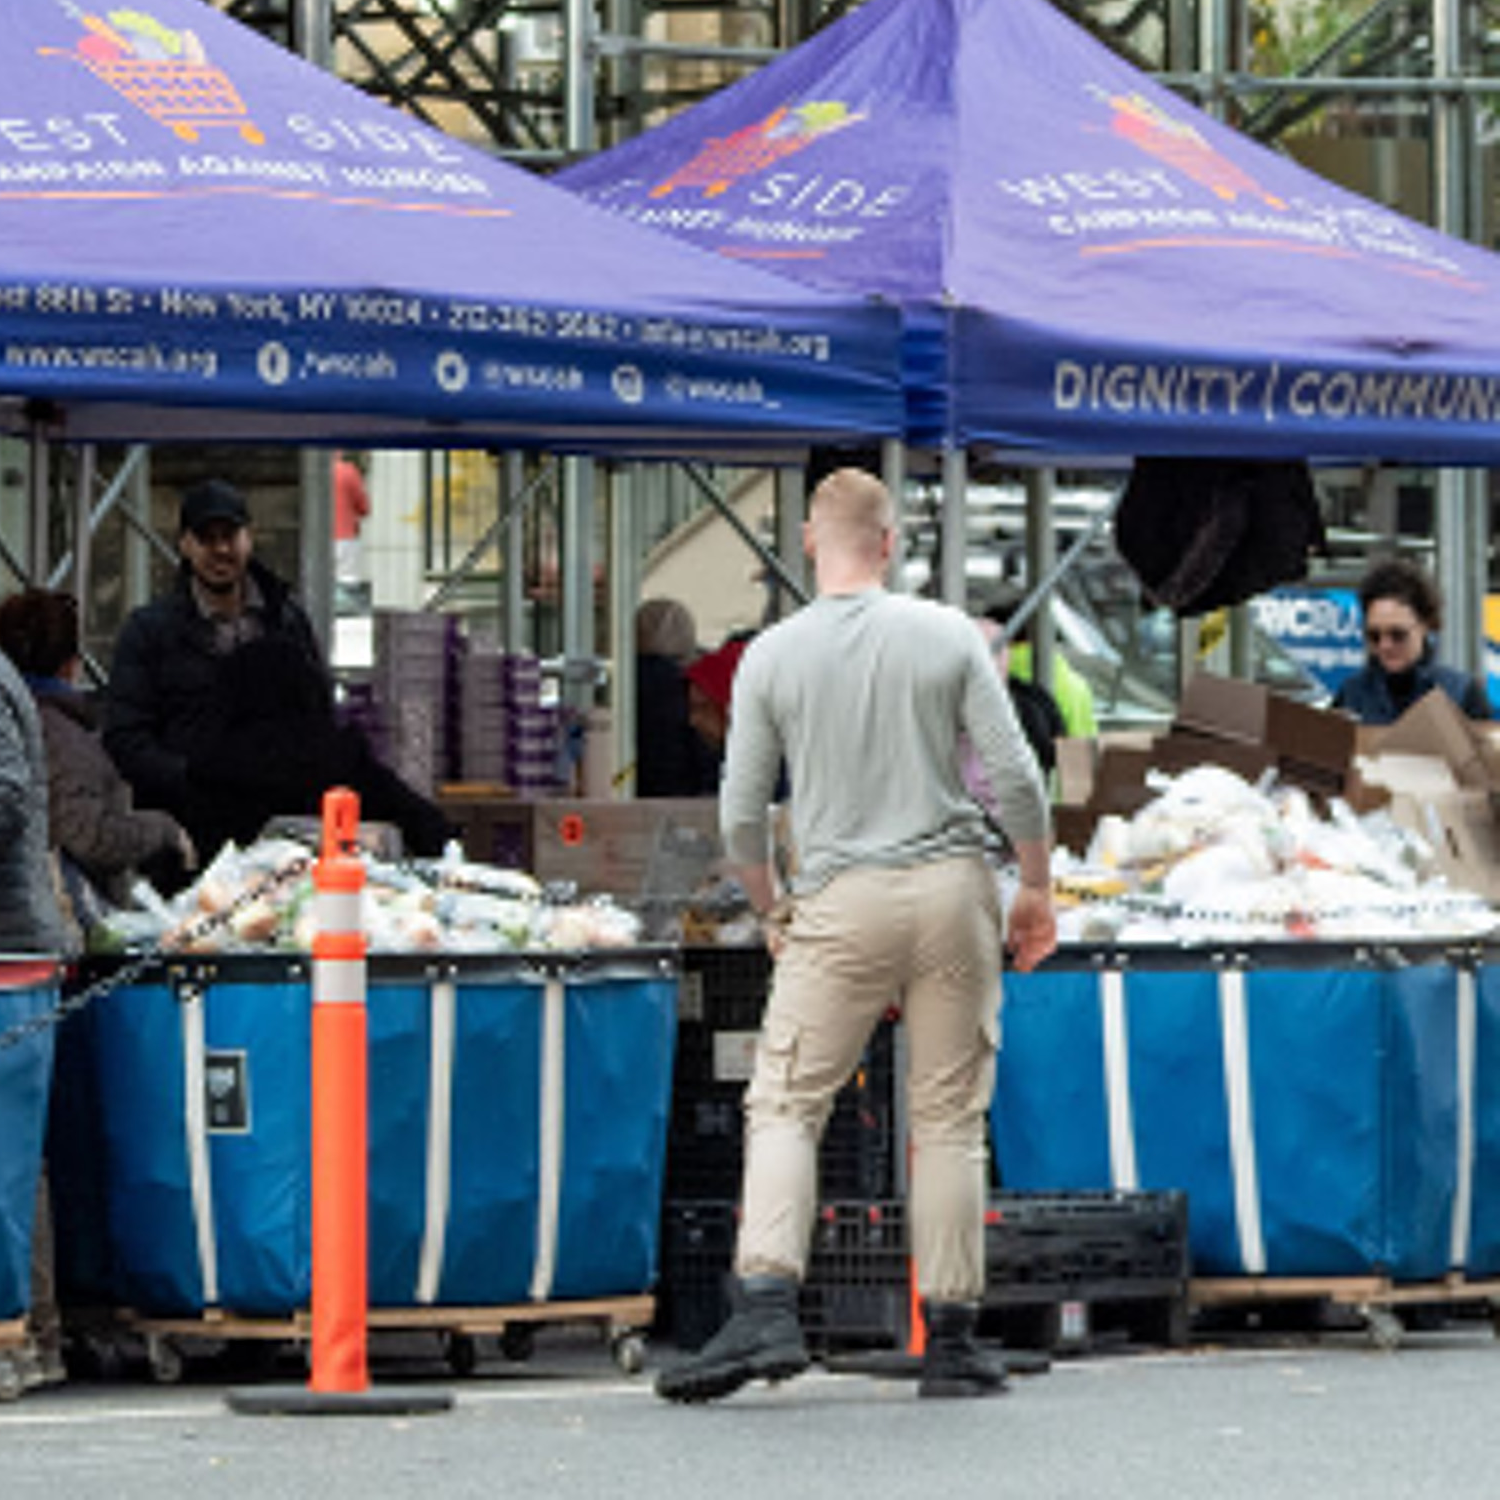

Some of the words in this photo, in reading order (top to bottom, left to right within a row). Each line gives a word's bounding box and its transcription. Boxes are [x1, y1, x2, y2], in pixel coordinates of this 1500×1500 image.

[286, 113, 464, 164] SIDE
[178, 155, 332, 186] AGAINST
[996, 168, 1183, 204] WEST
[749, 172, 911, 218] SIDE
[160, 286, 218, 319] New
[226, 291, 291, 327] York,
[299, 291, 338, 320] NY
[1053, 359, 1256, 417] DIGNITY
